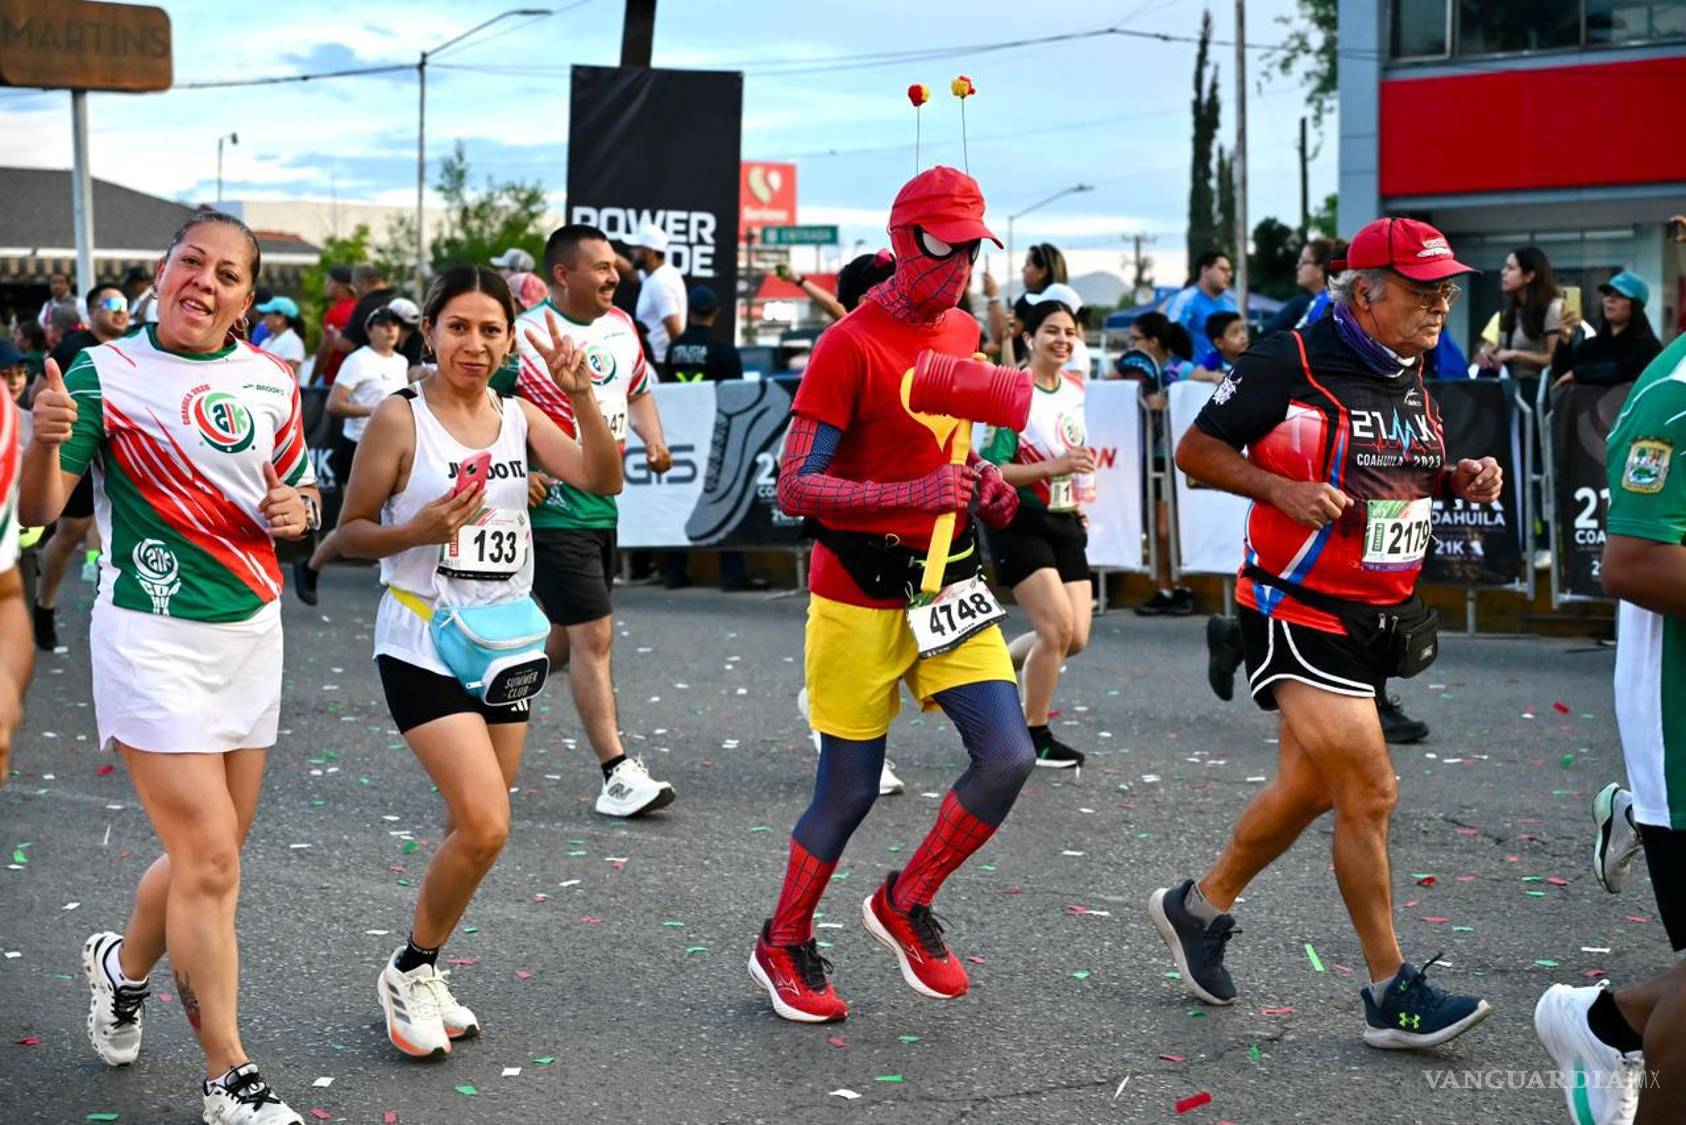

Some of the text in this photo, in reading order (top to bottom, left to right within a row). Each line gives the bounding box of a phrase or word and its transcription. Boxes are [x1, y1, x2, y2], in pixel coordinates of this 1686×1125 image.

[1, 17, 170, 58] MARTINS
[1356, 453, 1441, 469] COAHUILA 2023
[1431, 511, 1506, 526] OAHUILA
[1387, 520, 1430, 554] 2179
[473, 529, 517, 564] 133
[1434, 541, 1464, 555] 21K
[929, 592, 993, 636] 4748
[505, 671, 538, 688] SUMMER
[507, 686, 530, 699] CLUB
